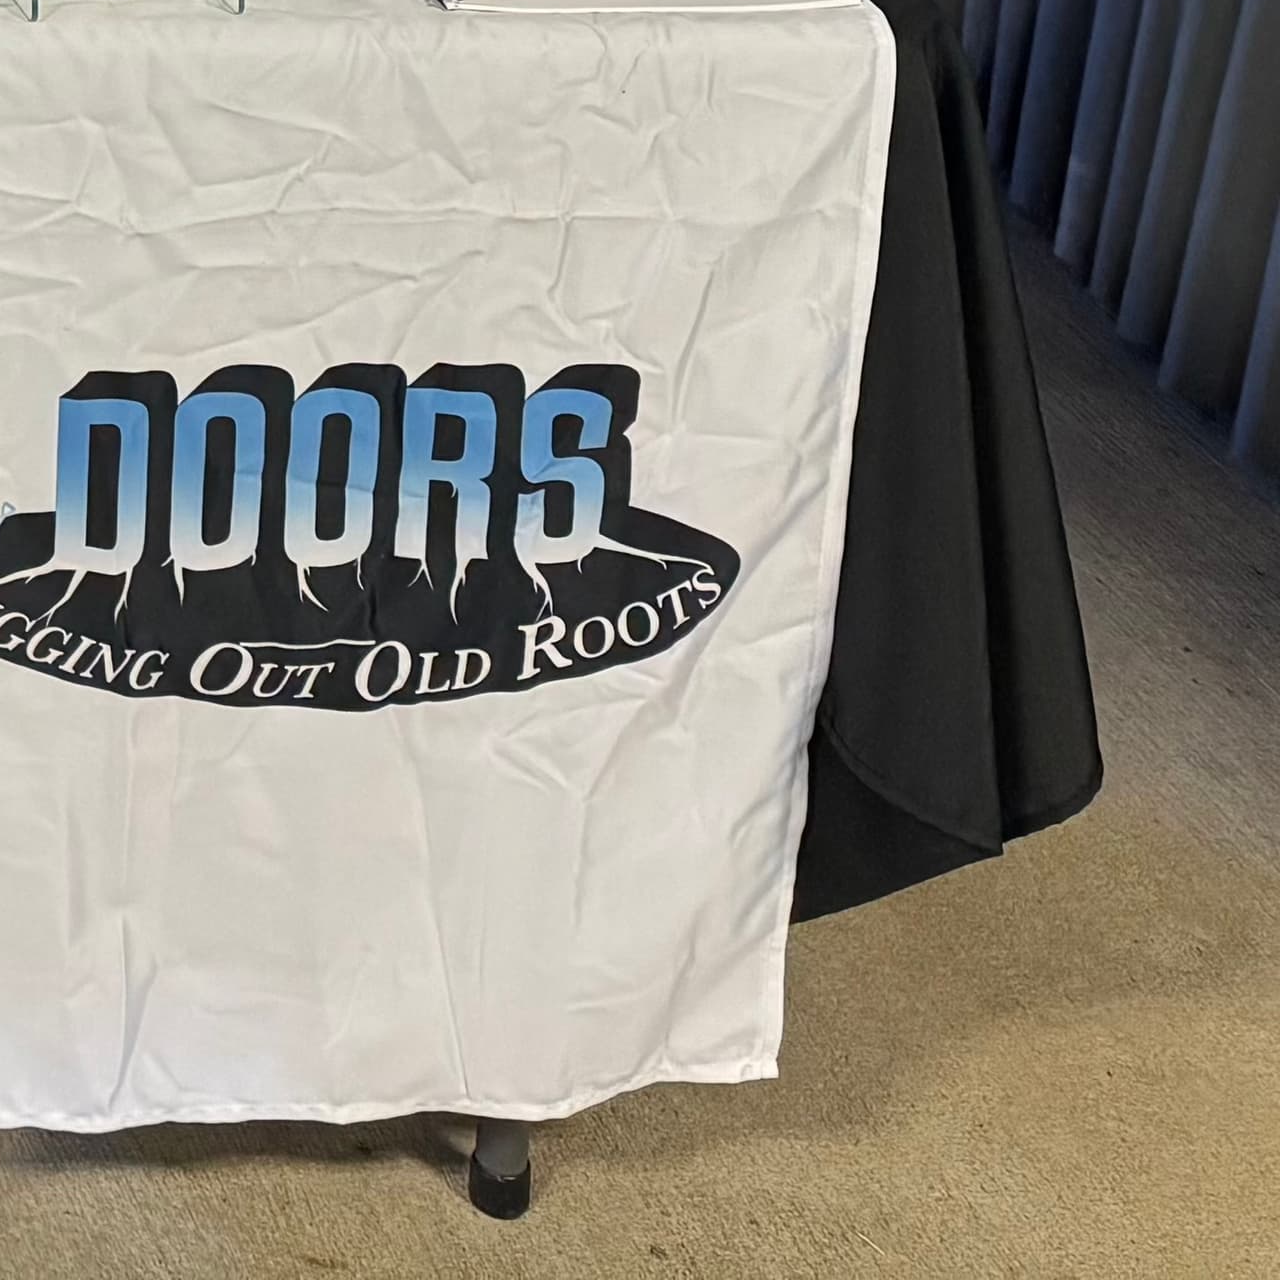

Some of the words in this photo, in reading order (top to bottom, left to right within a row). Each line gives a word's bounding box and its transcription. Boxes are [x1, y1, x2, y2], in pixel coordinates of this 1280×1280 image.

[53, 365, 641, 575] DOORS
[188, 640, 338, 703] OUT
[354, 638, 493, 704] OLD
[514, 567, 728, 683] ROOTS
